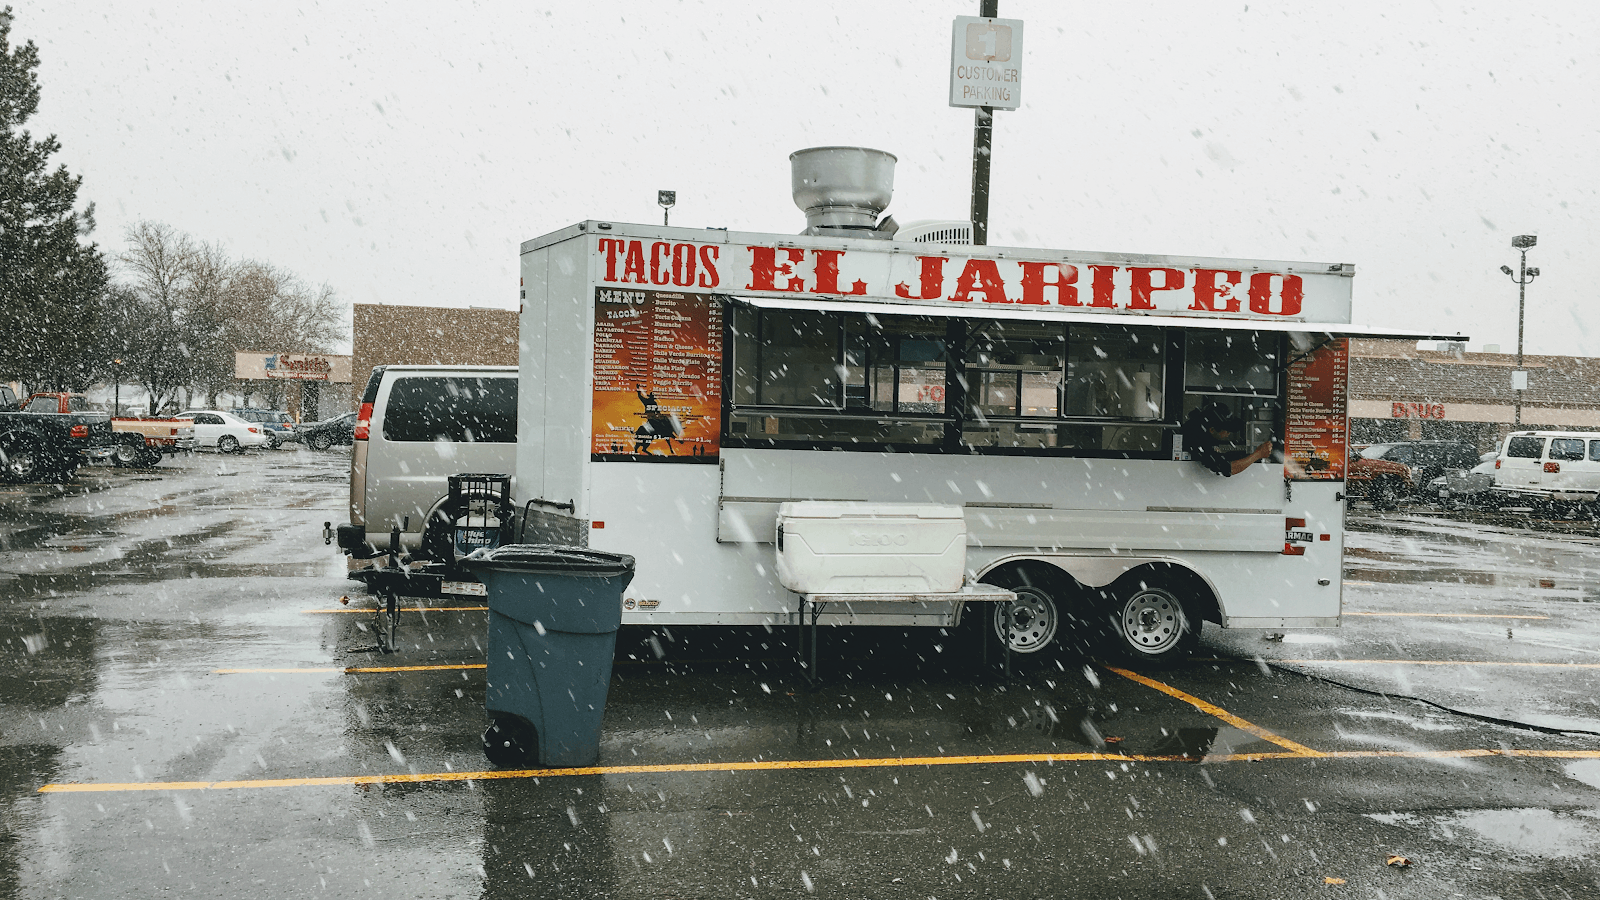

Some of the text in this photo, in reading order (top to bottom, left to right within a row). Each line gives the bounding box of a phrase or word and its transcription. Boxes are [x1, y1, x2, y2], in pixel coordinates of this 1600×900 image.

[957, 65, 1018, 82] CUSTOMER
[963, 85, 1011, 101] PARKING
[598, 238, 1306, 317] TACOS EL JARIPEO
[600, 290, 646, 304] MENU
[606, 310, 636, 318] TACOS
[646, 404, 692, 412] SPECIALTY
[1392, 402, 1446, 420] DRUG
[848, 532, 910, 547] IGLOO
